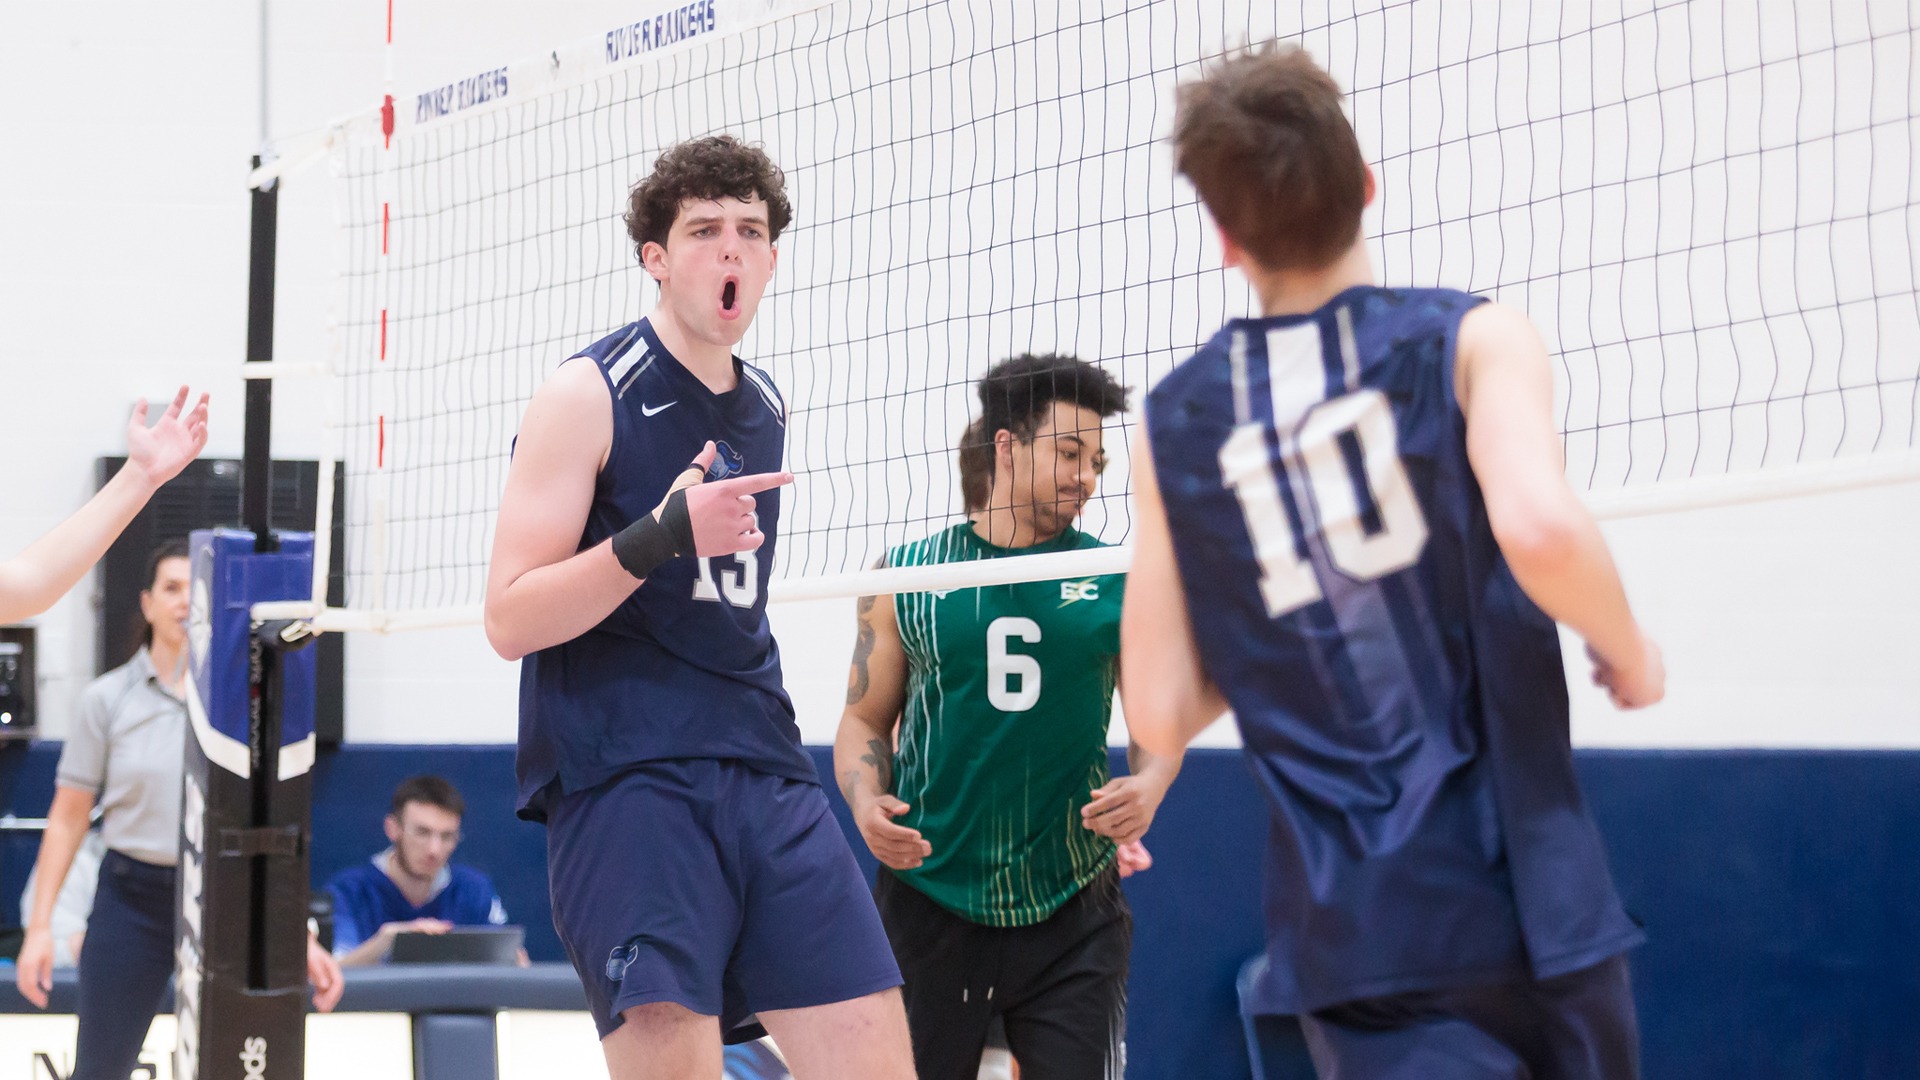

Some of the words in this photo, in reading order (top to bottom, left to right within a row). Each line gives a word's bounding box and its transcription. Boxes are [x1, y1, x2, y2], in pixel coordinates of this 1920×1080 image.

[1217, 387, 1429, 619] 10
[1060, 581, 1099, 601] EC
[986, 616, 1042, 712] 6
